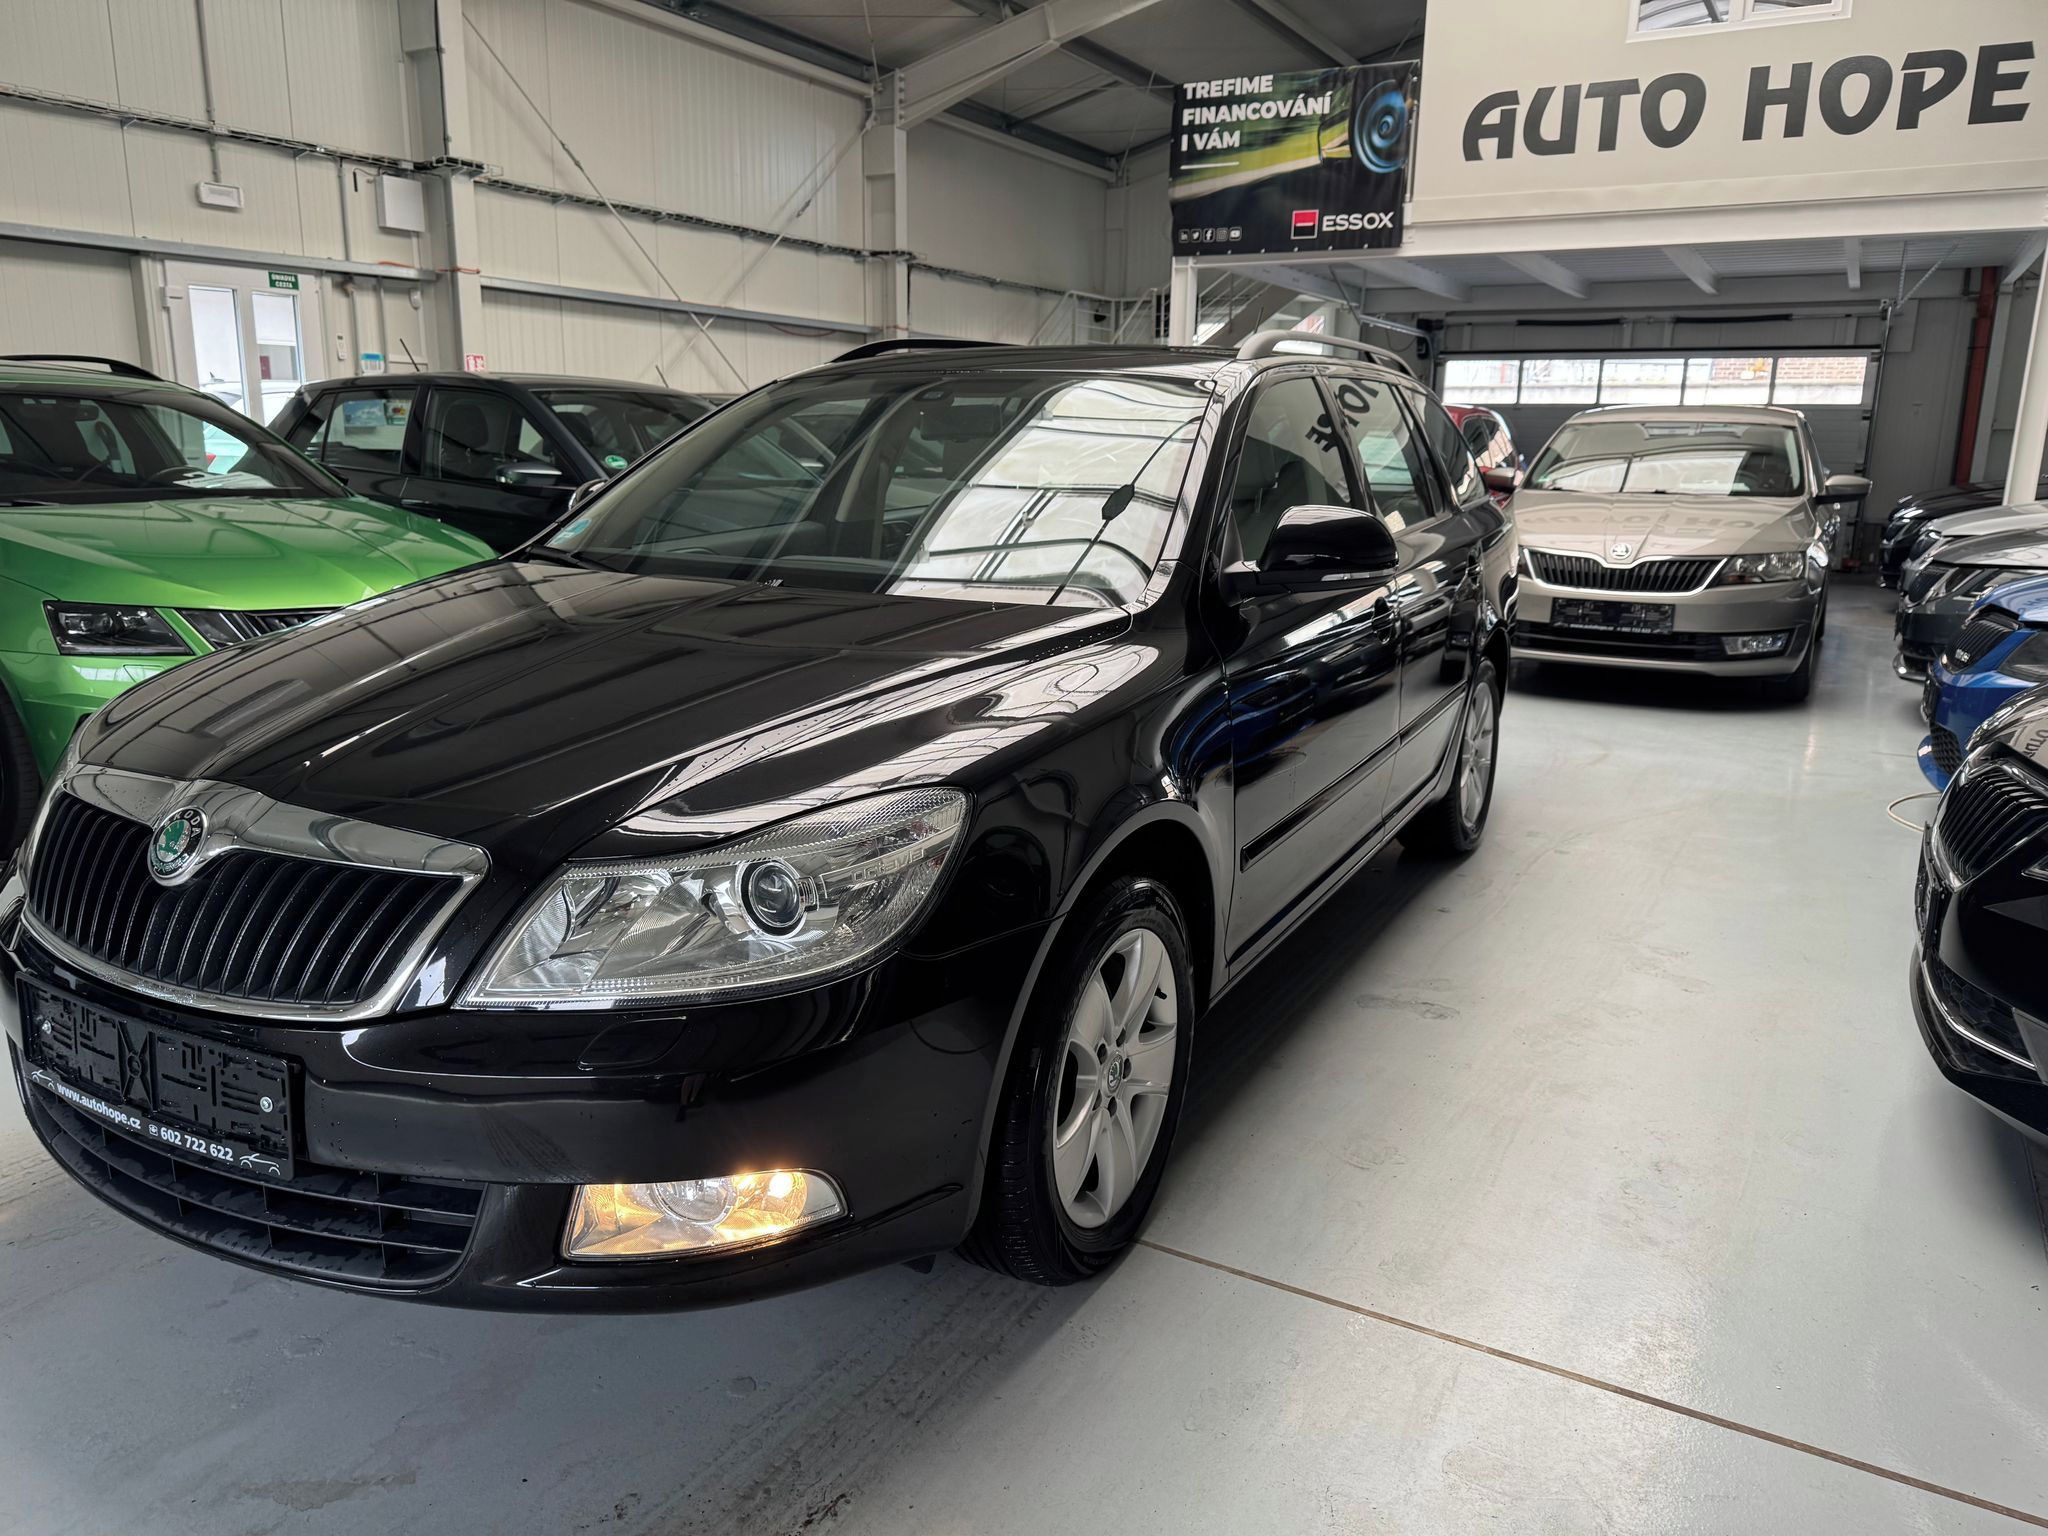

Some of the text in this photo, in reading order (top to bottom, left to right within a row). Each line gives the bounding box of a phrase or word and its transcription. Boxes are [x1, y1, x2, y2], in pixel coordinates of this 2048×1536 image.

[1183, 74, 1274, 100] TREFIME
[1462, 40, 2036, 162] AUTO HOPE
[1182, 91, 1334, 126] FINANCOVÁNÍ
[1180, 127, 1241, 152] I VÁM
[1322, 212, 1395, 232] ESSOX
[57, 1083, 234, 1162] www.autohope.cz 602 722 622
